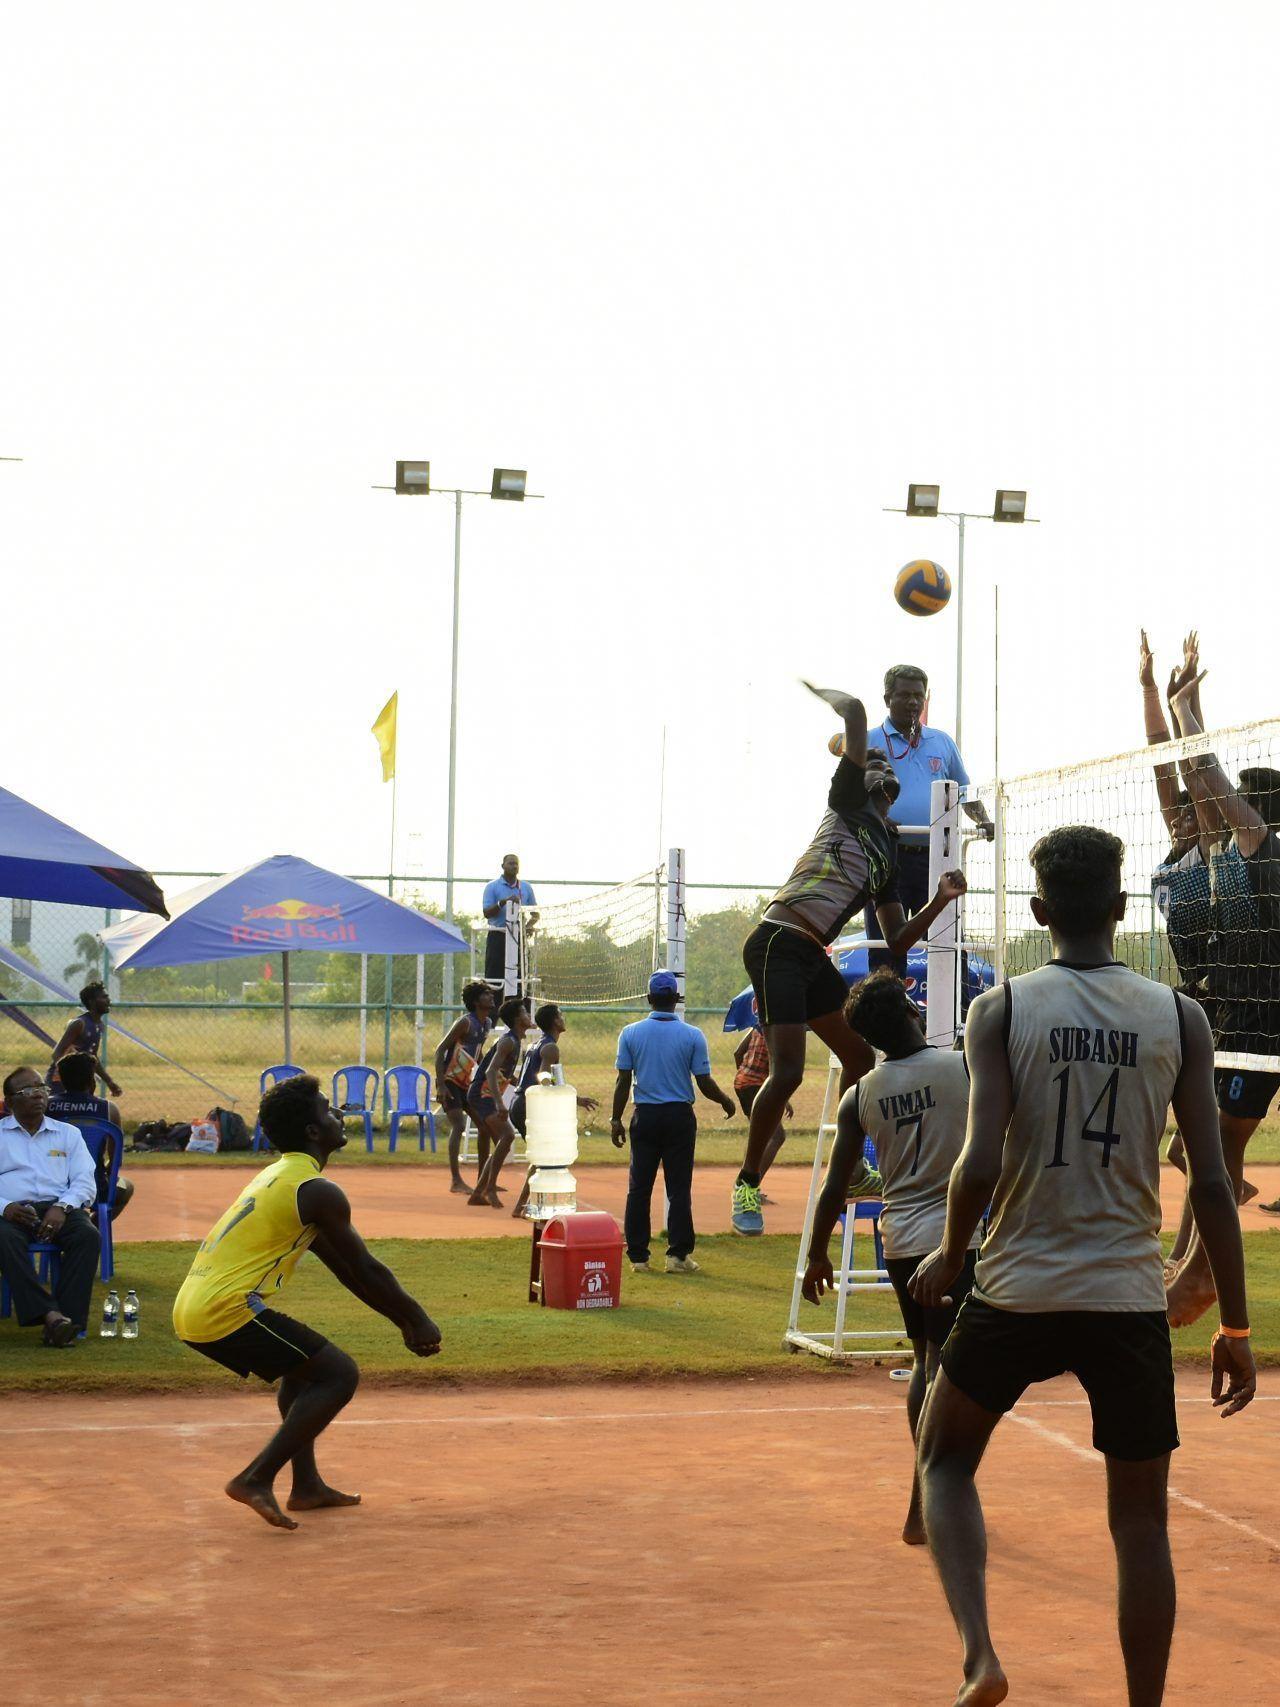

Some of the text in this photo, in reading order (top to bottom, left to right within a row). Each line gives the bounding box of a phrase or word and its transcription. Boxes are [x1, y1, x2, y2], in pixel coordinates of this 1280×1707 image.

[232, 920, 357, 944] Red Bull
[1049, 1027, 1138, 1067] SUBASH
[878, 1085, 936, 1120] VIMAL
[1229, 1076, 1243, 1100] 8
[49, 1102, 98, 1112] CHENNAI
[1045, 1065, 1120, 1168] 14
[896, 1113, 924, 1176] 7
